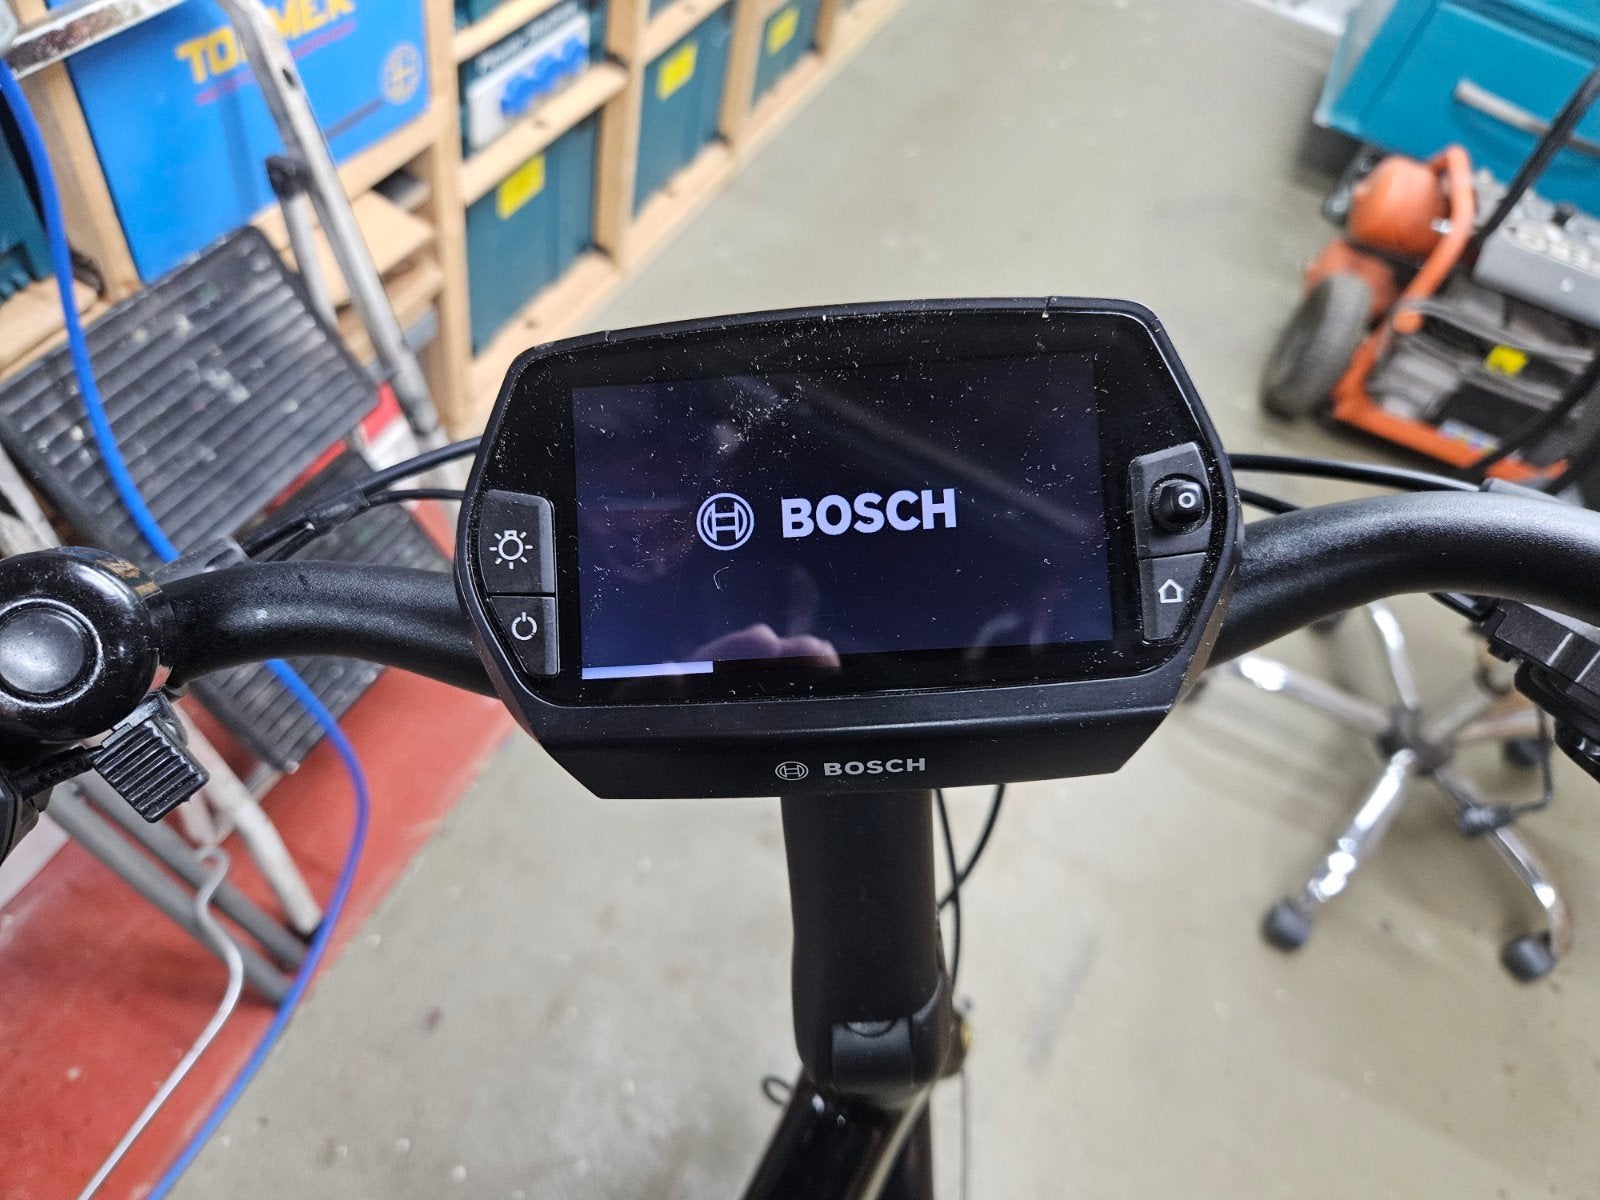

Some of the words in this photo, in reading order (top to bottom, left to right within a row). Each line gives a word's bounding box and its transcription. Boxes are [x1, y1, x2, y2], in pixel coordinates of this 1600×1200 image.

[174, 0, 357, 84] TOME
[781, 488, 957, 538] BOSCH
[823, 757, 926, 776] BOSCH
